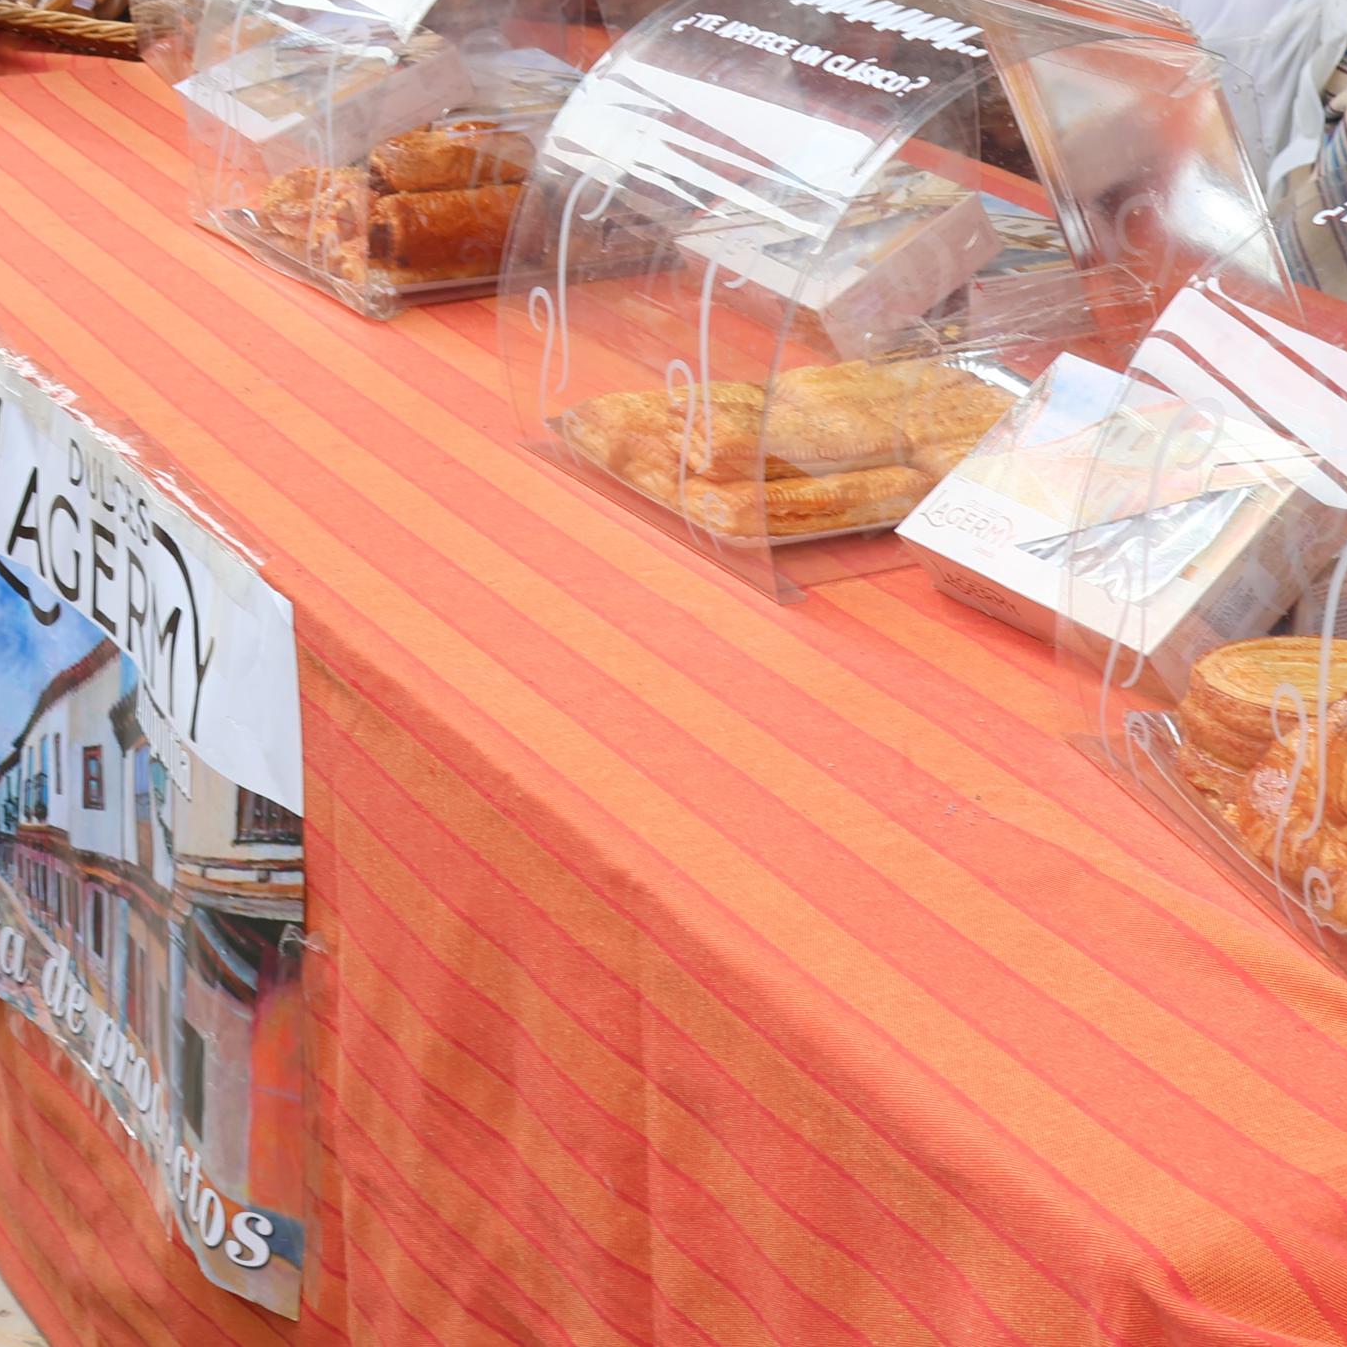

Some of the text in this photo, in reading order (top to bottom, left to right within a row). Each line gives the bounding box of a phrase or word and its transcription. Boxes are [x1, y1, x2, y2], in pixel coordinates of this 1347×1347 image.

[671, 11, 931, 98] ¿TE APETECE UN CLÁSICO?
[69, 438, 149, 546] DULCES
[41, 943, 87, 1034] de
[91, 1013, 274, 1269] proctos
